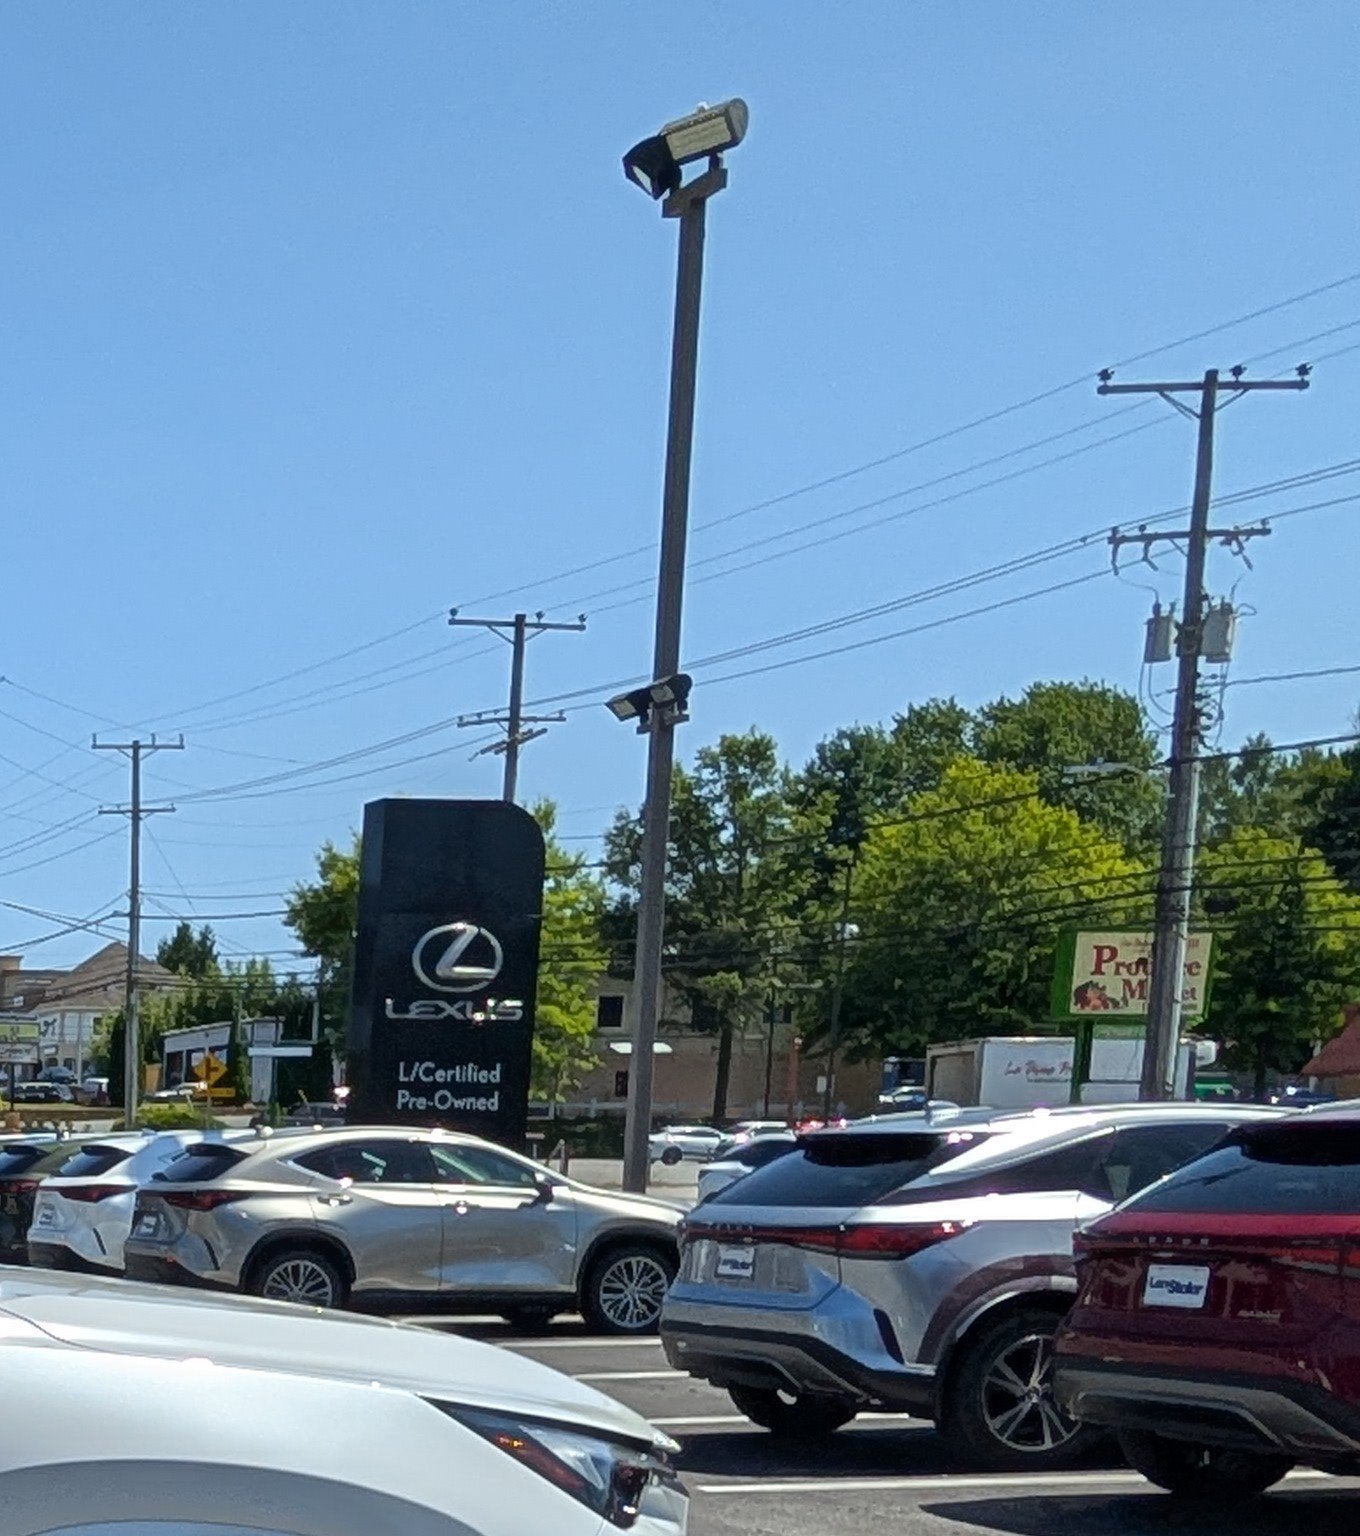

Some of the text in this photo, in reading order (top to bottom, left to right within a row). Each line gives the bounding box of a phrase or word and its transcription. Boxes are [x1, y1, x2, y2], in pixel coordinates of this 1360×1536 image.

[385, 998, 524, 1021] LEXUS
[398, 1061, 502, 1083] L/Certified
[396, 1089, 500, 1112] Pre-Owned
